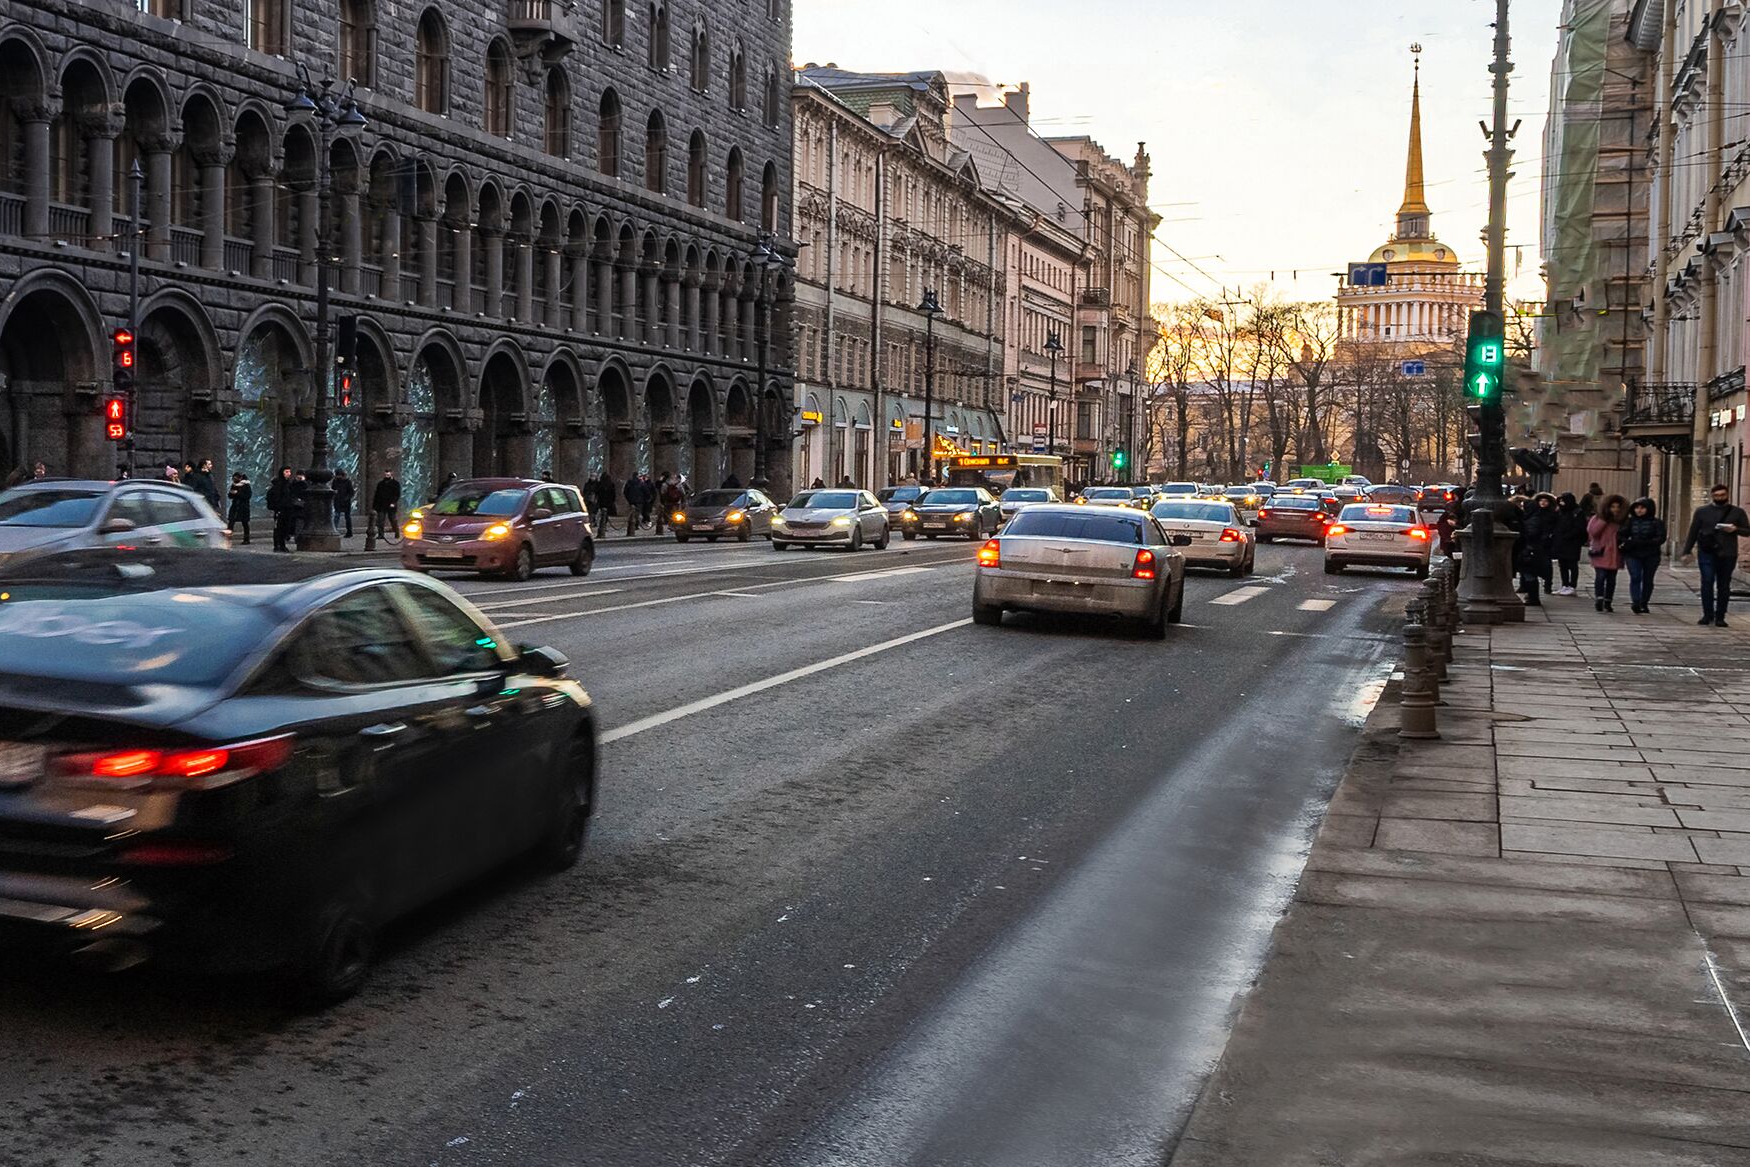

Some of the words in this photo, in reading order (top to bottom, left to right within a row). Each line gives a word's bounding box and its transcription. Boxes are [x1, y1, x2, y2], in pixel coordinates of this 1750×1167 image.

[123, 352, 132, 365] 6
[1481, 346, 1497, 362] 13
[109, 424, 123, 436] 53
